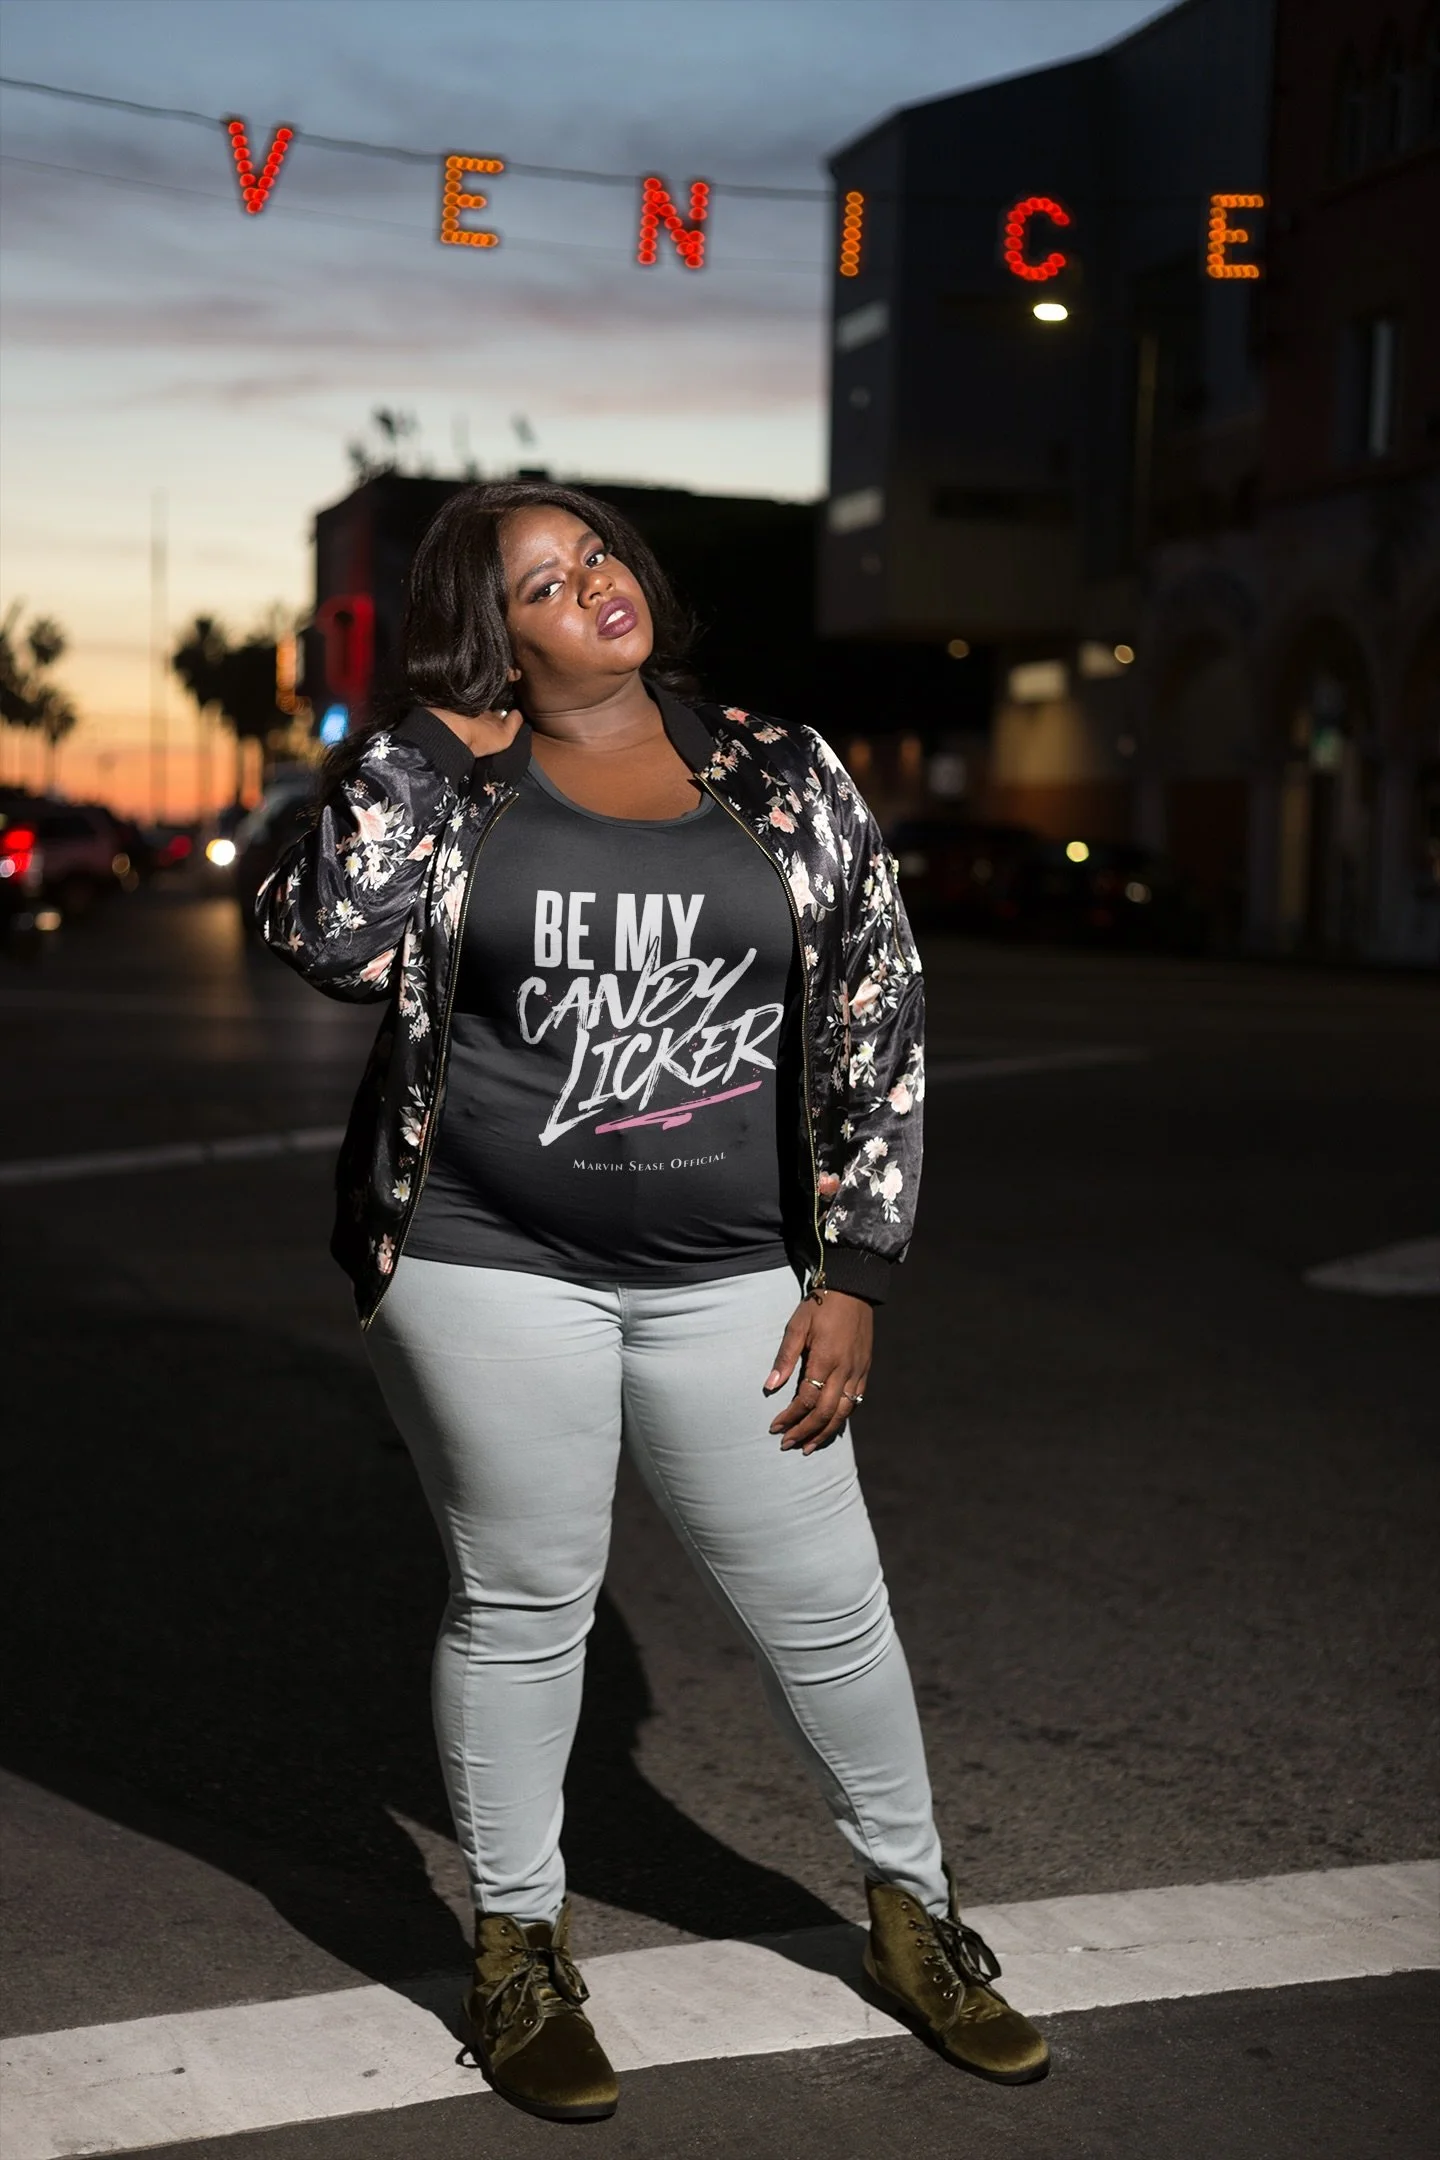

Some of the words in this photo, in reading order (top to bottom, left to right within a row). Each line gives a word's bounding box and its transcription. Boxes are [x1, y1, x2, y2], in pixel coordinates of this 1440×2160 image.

[227, 120, 1264, 280] VENICE
[516, 936, 757, 1044] CANDY
[534, 890, 596, 970] BE
[615, 893, 705, 971] MY
[538, 1003, 784, 1146] LICKER
